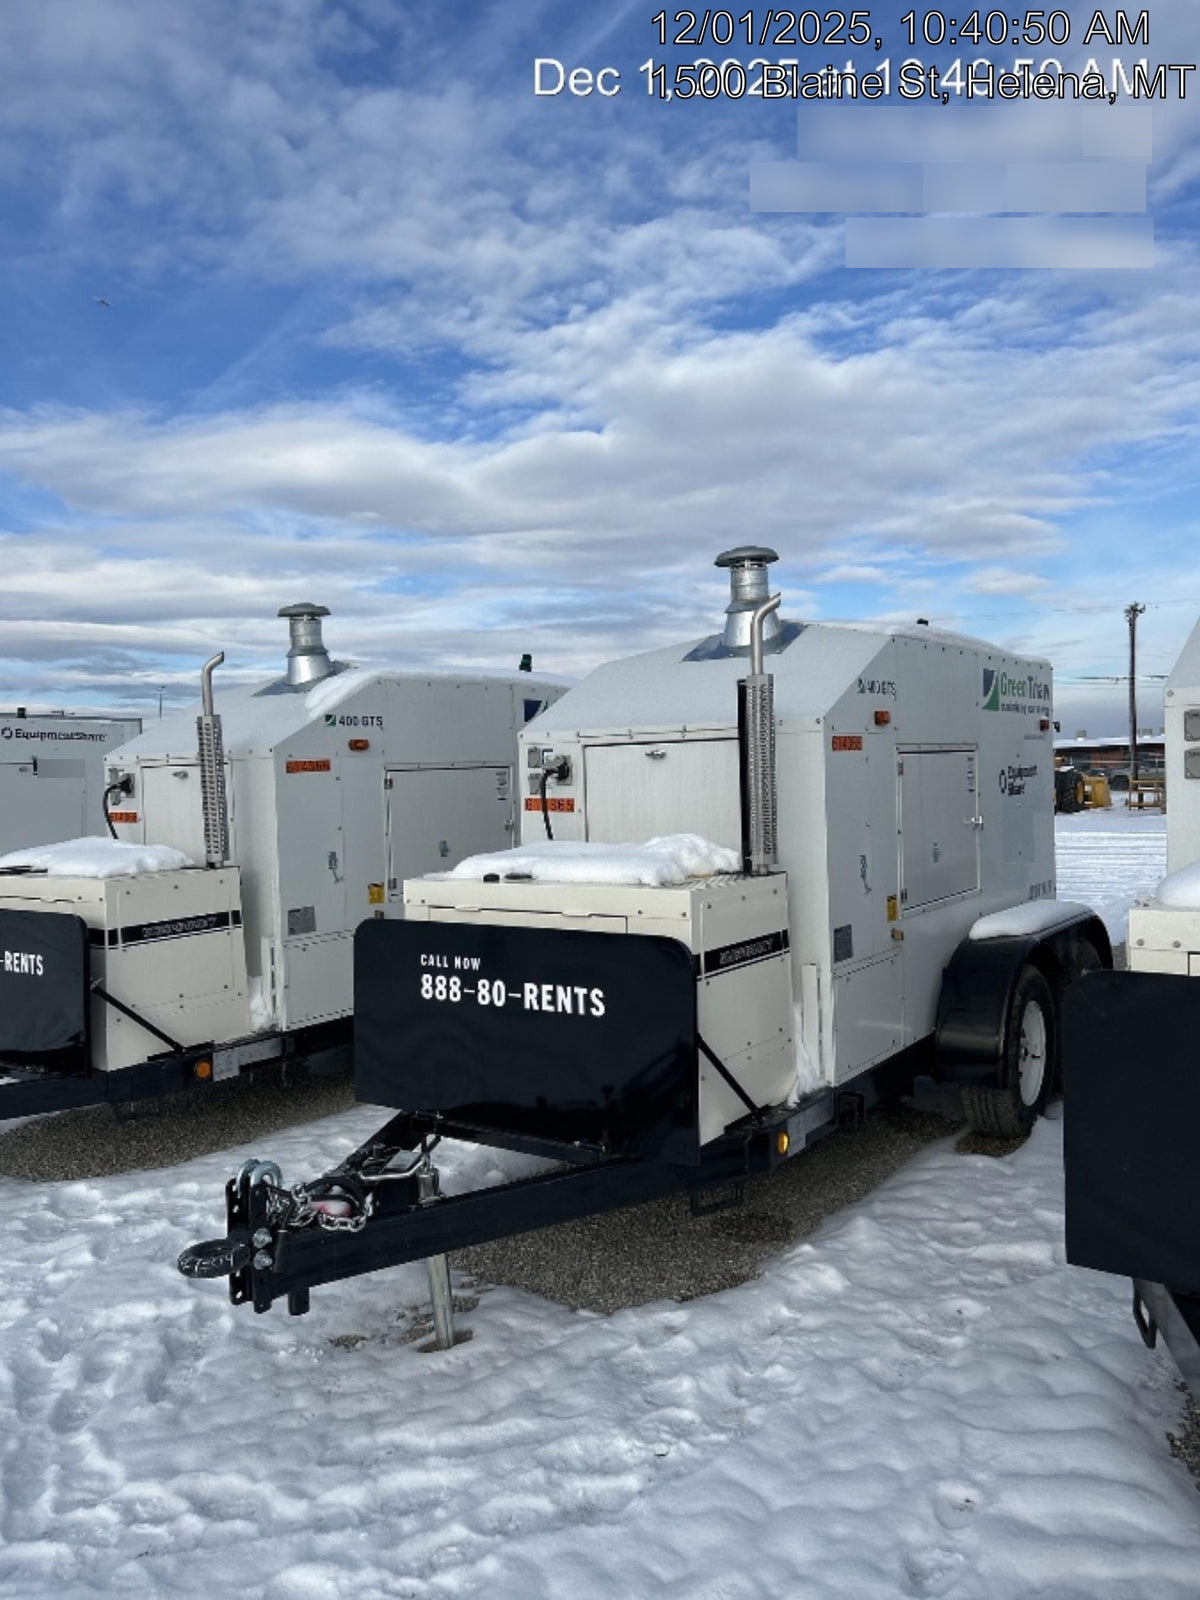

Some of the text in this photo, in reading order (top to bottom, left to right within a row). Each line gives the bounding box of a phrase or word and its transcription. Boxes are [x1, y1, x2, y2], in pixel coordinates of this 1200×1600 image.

[420, 954, 481, 971] CALL NOW
[420, 973, 606, 1017] 888-80-RENTS
